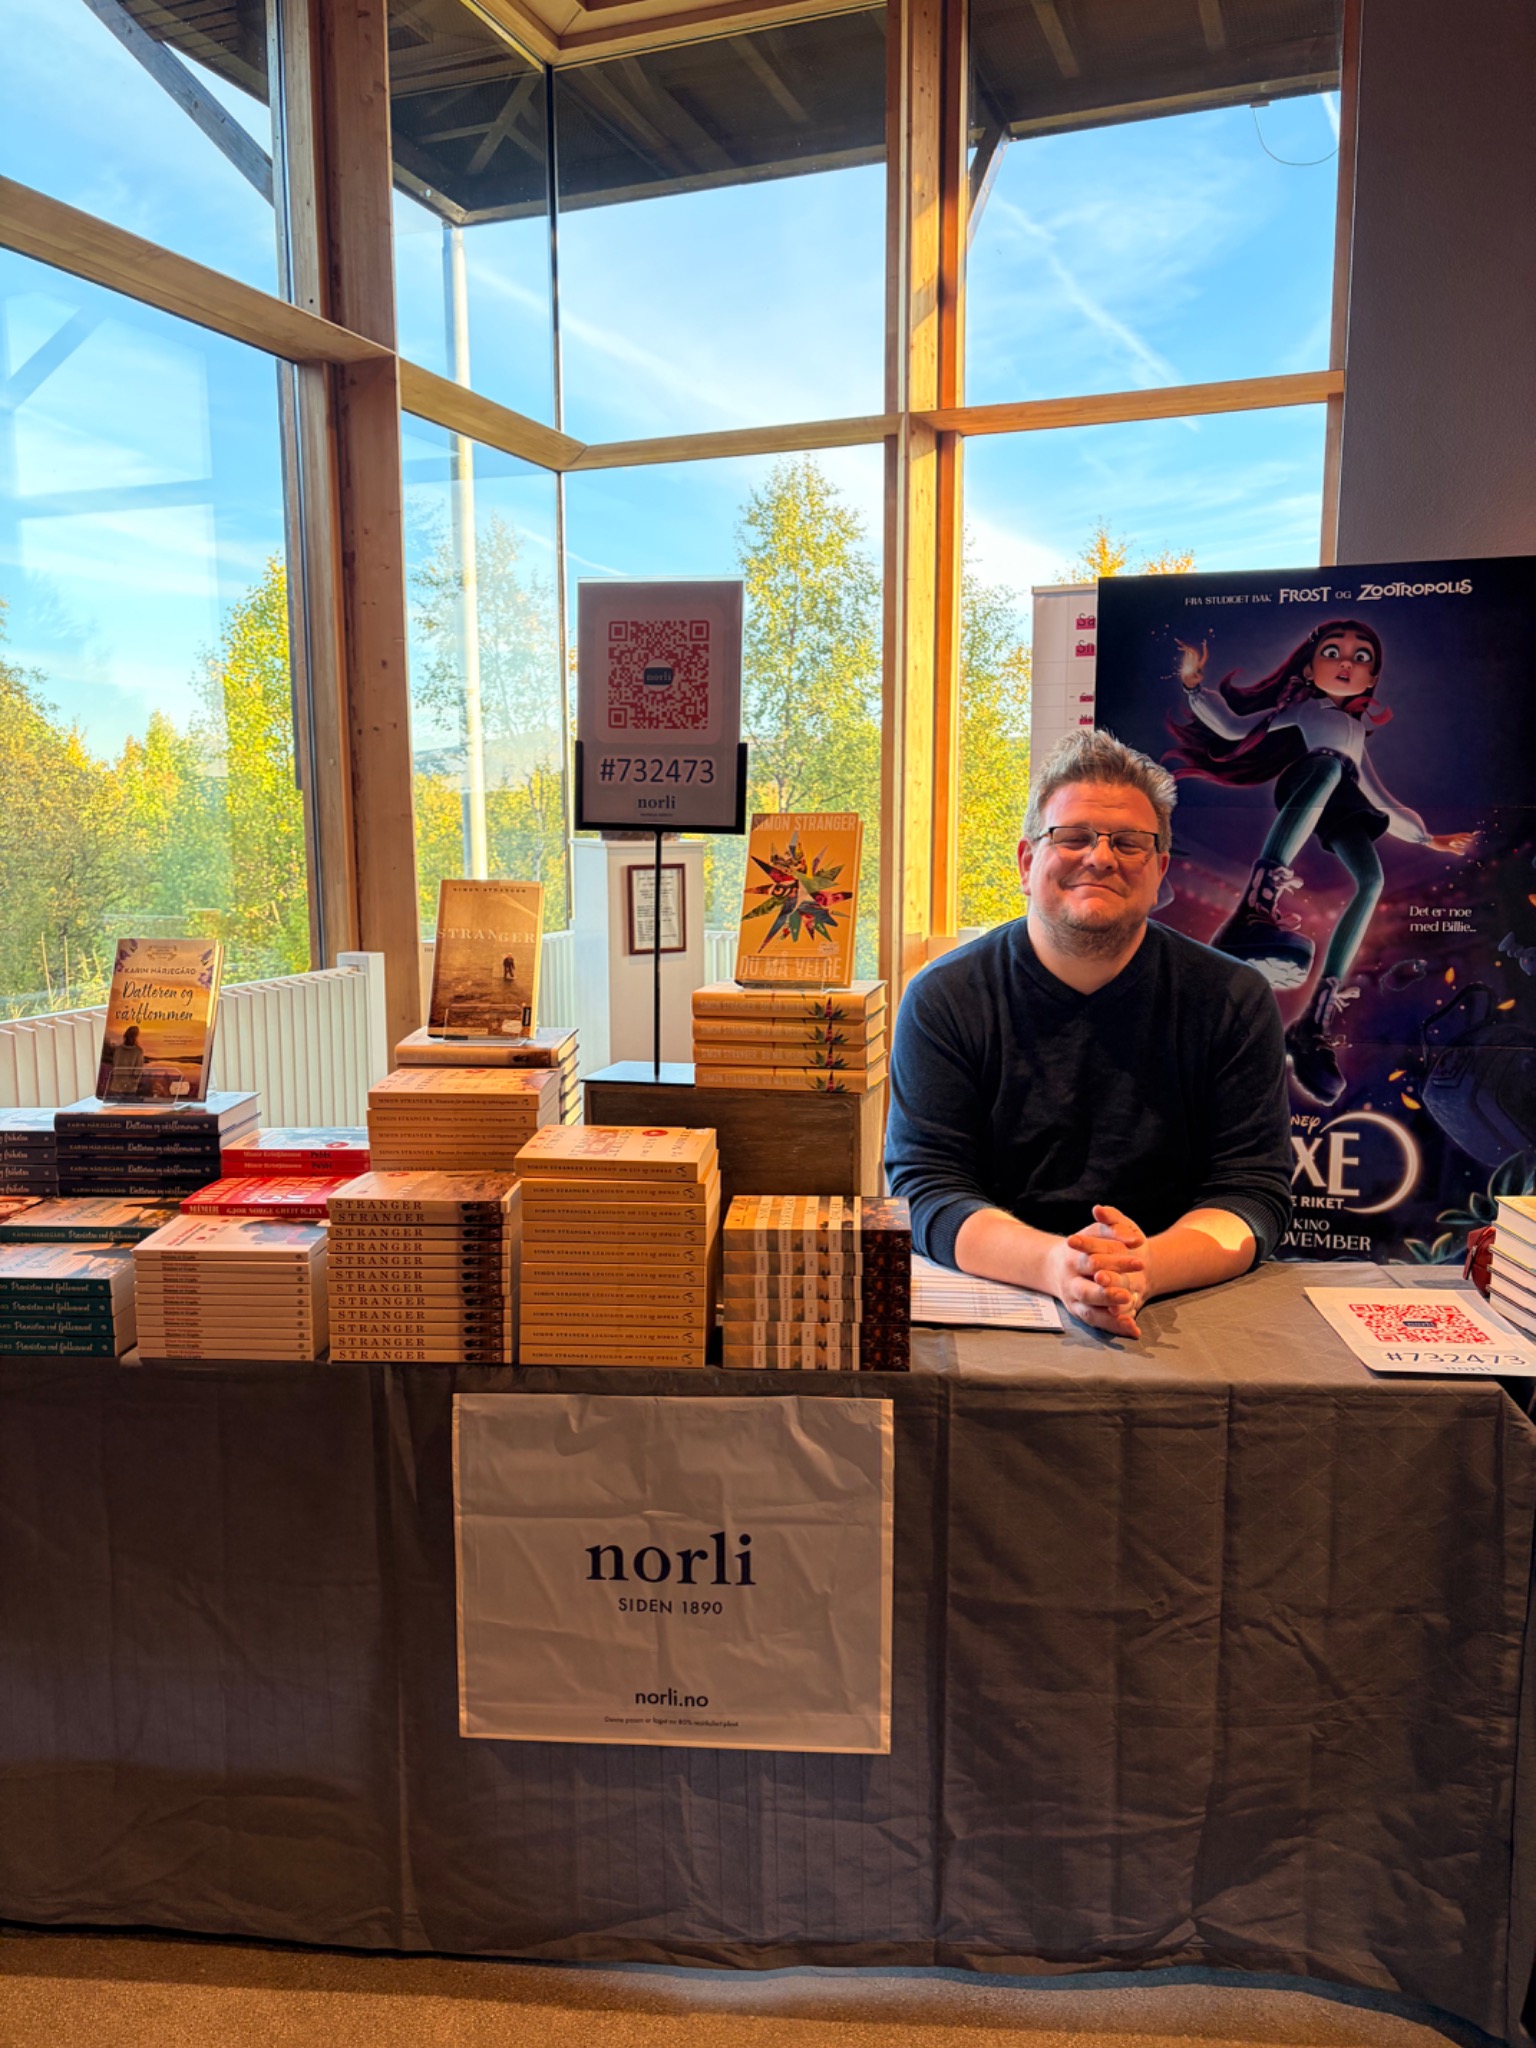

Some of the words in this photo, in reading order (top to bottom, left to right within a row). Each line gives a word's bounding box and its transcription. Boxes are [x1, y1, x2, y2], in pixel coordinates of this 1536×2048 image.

[1279, 586, 1332, 605] FROST
[1335, 590, 1351, 599] OG
[600, 758, 715, 783] #732473
[637, 795, 676, 809] norli
[754, 814, 790, 832] SIMON
[795, 814, 856, 832] STRANGER
[1409, 905, 1429, 917] Det
[1431, 907, 1447, 918] er
[1449, 908, 1473, 918] noe
[1409, 920, 1440, 932] med
[438, 927, 537, 944] STRANGER
[124, 966, 149, 974] KARIN
[741, 955, 760, 977] DU
[764, 950, 789, 978] MÅ
[796, 956, 843, 979] VELGE
[122, 980, 178, 999] Datteren
[180, 989, 194, 1007] og
[1290, 1113, 1321, 1135] NEY
[1290, 1131, 1360, 1197] XE
[335, 1200, 422, 1211] STRANGER
[1300, 1195, 1345, 1210] RIKET
[338, 1212, 425, 1223] STRANGER
[1293, 1217, 1330, 1232] KINO
[335, 1227, 424, 1238] STRANGER
[335, 1242, 423, 1252] STRANGER
[1281, 1231, 1371, 1252] VEMBER
[335, 1255, 424, 1266] STRANGER
[335, 1270, 424, 1281] STRANGER
[336, 1283, 424, 1294] STRANGER
[338, 1296, 426, 1307] STRANGER
[337, 1310, 426, 1321] STRANGER
[338, 1323, 426, 1334] STRANGER
[338, 1336, 426, 1348] STRANGER
[338, 1350, 426, 1361] STRANGER
[1385, 1352, 1526, 1366] #732473
[585, 1530, 757, 1586] norli
[618, 1597, 673, 1614] SIDEN
[682, 1600, 723, 1615] 1890
[634, 1687, 709, 1708] norli.no
